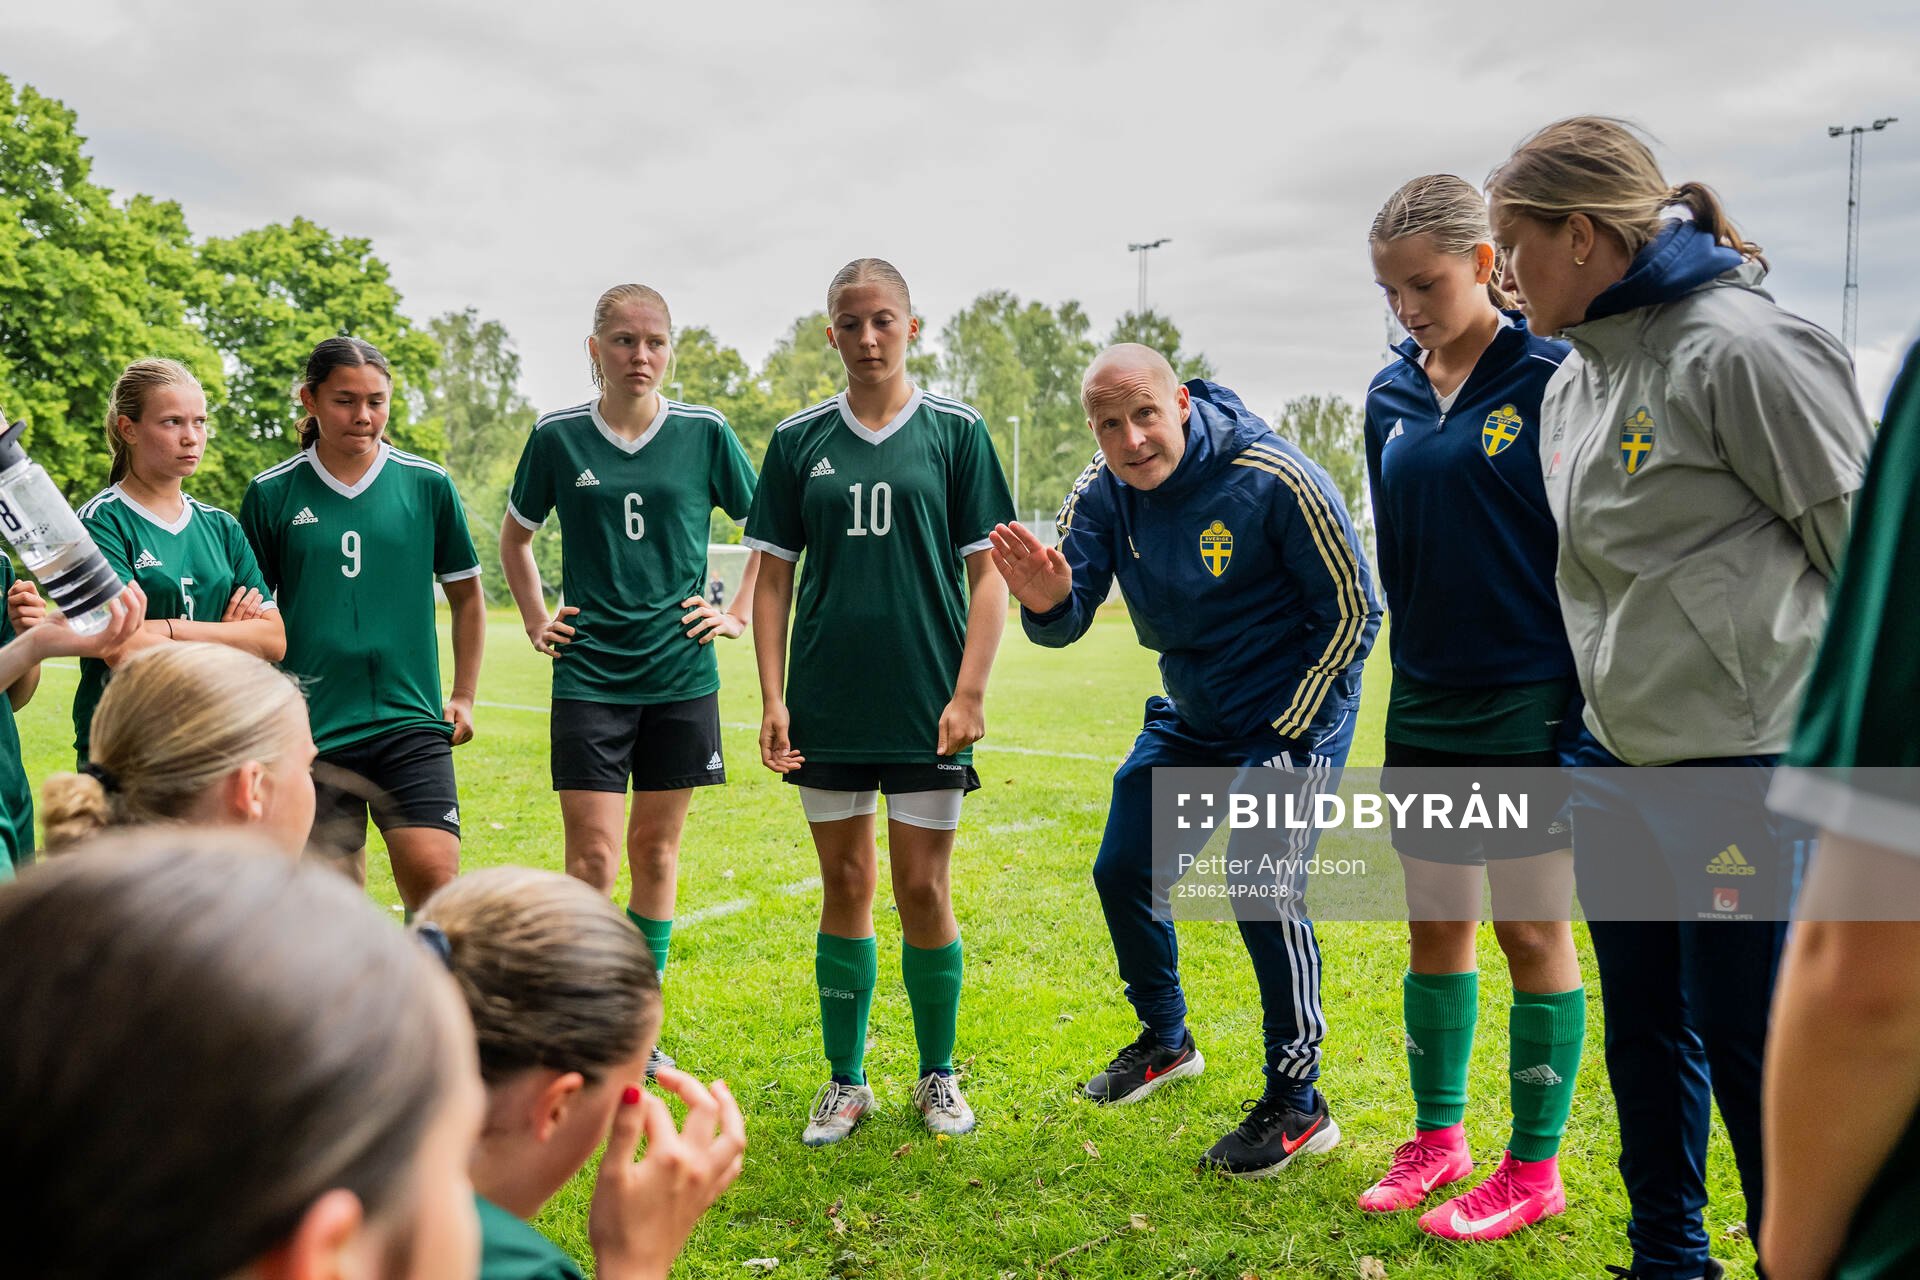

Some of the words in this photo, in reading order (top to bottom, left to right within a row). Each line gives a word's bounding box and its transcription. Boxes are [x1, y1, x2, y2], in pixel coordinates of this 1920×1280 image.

[810, 467, 836, 478] adidas
[292, 516, 319, 526] adidas
[624, 492, 645, 540] 6
[847, 481, 892, 536] 10
[341, 530, 361, 578] 9
[180, 577, 194, 621] 5
[1706, 863, 1756, 875] adidas
